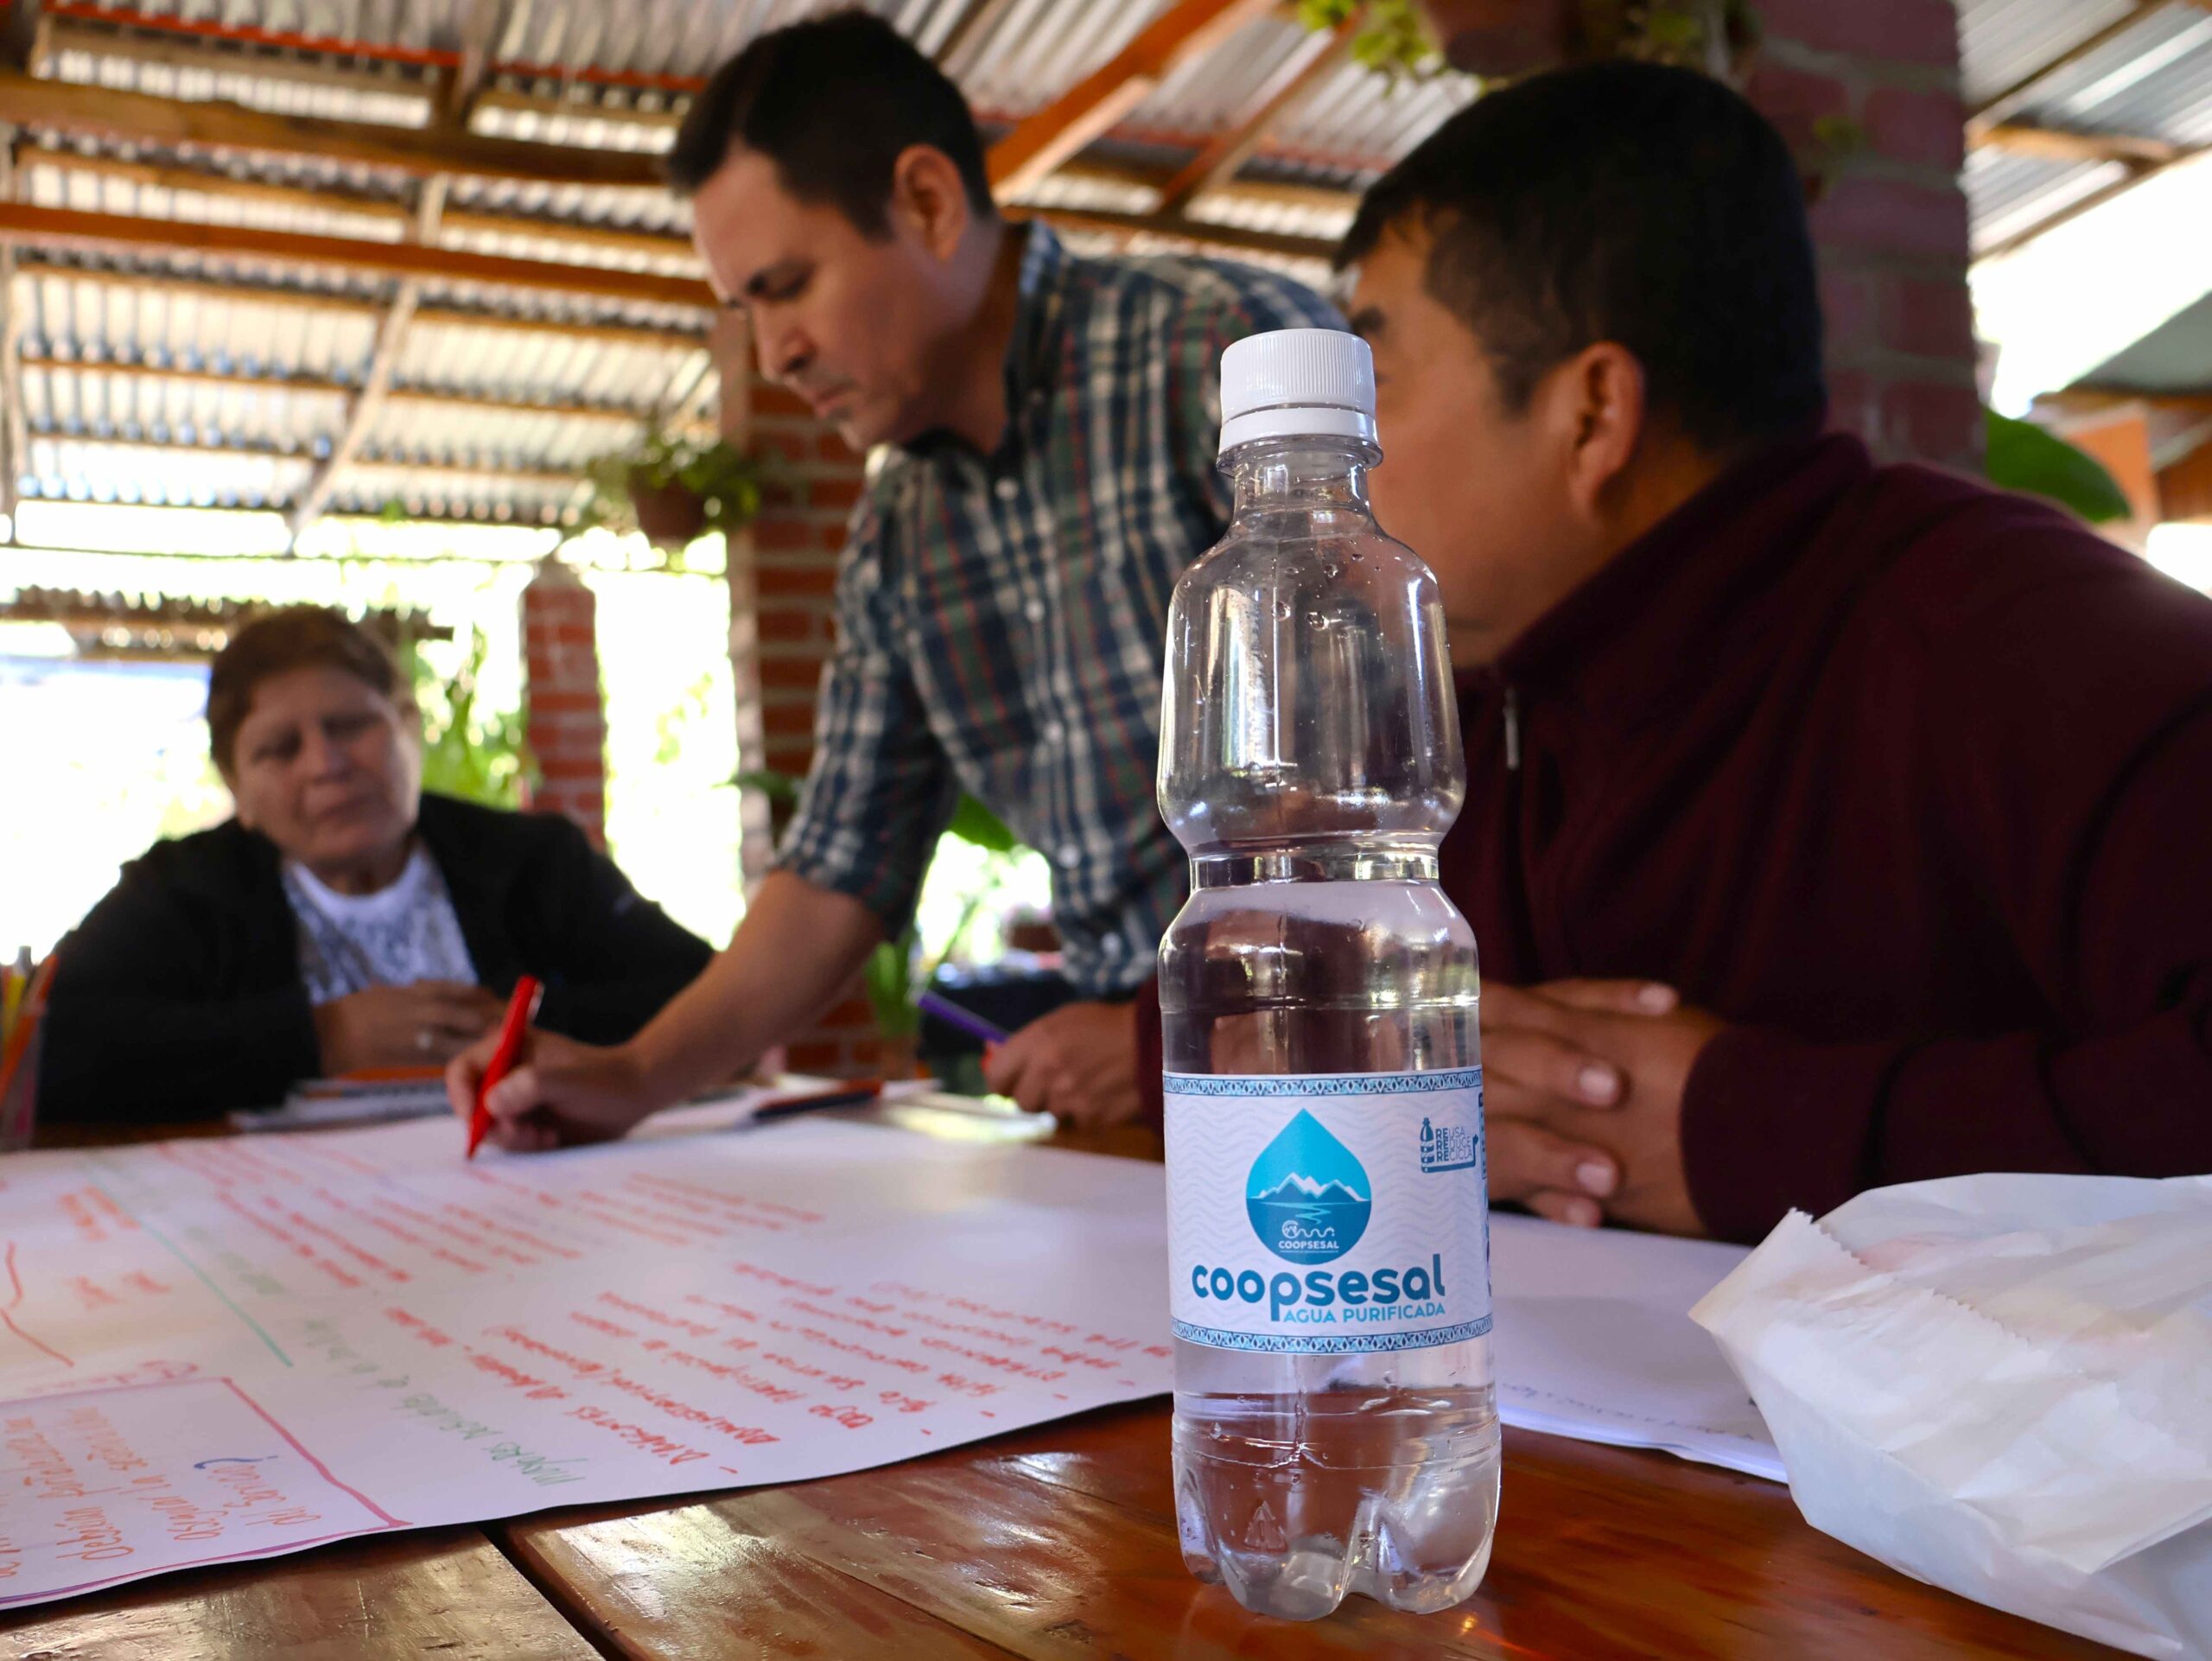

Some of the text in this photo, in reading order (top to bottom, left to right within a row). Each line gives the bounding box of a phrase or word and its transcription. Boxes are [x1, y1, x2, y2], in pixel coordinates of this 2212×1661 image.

[1435, 1127, 1465, 1140] REUSA
[1436, 1136, 1471, 1151] REDUCE
[1436, 1149, 1472, 1162] RECICLA
[1278, 1240, 1340, 1250] COOPSESAL
[1192, 1253, 1446, 1322] coopsesal
[1282, 1301, 1446, 1324] AGUA PURIFICADA
